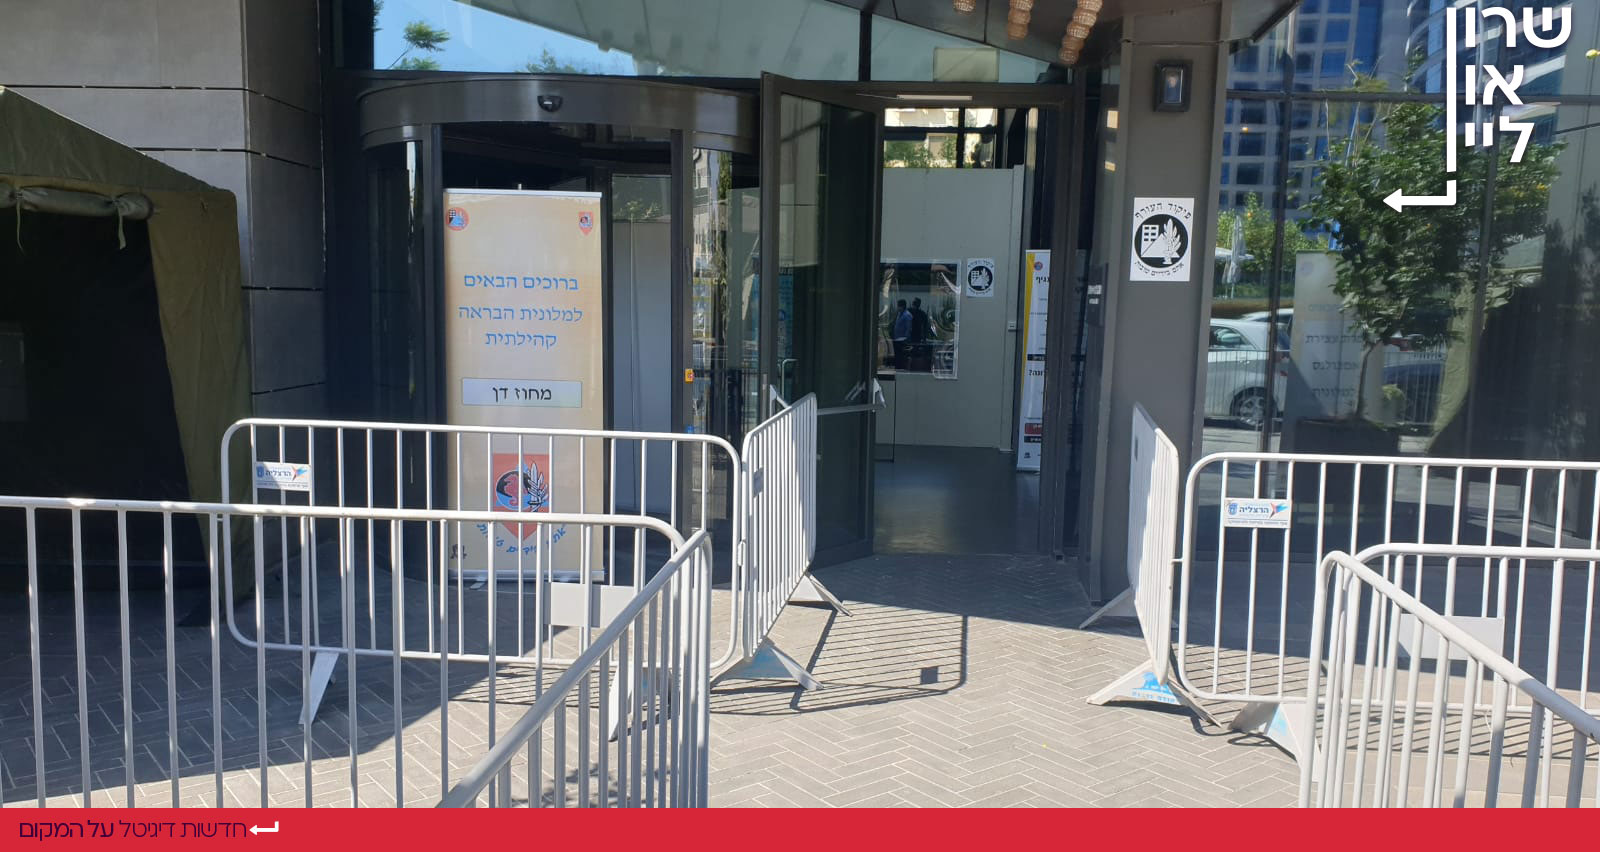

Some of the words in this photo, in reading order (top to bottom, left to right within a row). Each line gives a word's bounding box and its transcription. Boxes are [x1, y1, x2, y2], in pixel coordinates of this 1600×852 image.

[1135, 203, 1162, 219] העורף
[1168, 203, 1191, 219] פיקוד
[463, 274, 518, 289] הבאים
[522, 275, 579, 291] ברוכים
[458, 305, 515, 321] הבראה
[519, 306, 583, 322] למלונית
[484, 331, 557, 350] קהילתית
[492, 386, 509, 403] דן
[515, 387, 552, 400] מחוז
[265, 469, 292, 478] הרצליה
[1239, 505, 1269, 514] הרצליה
